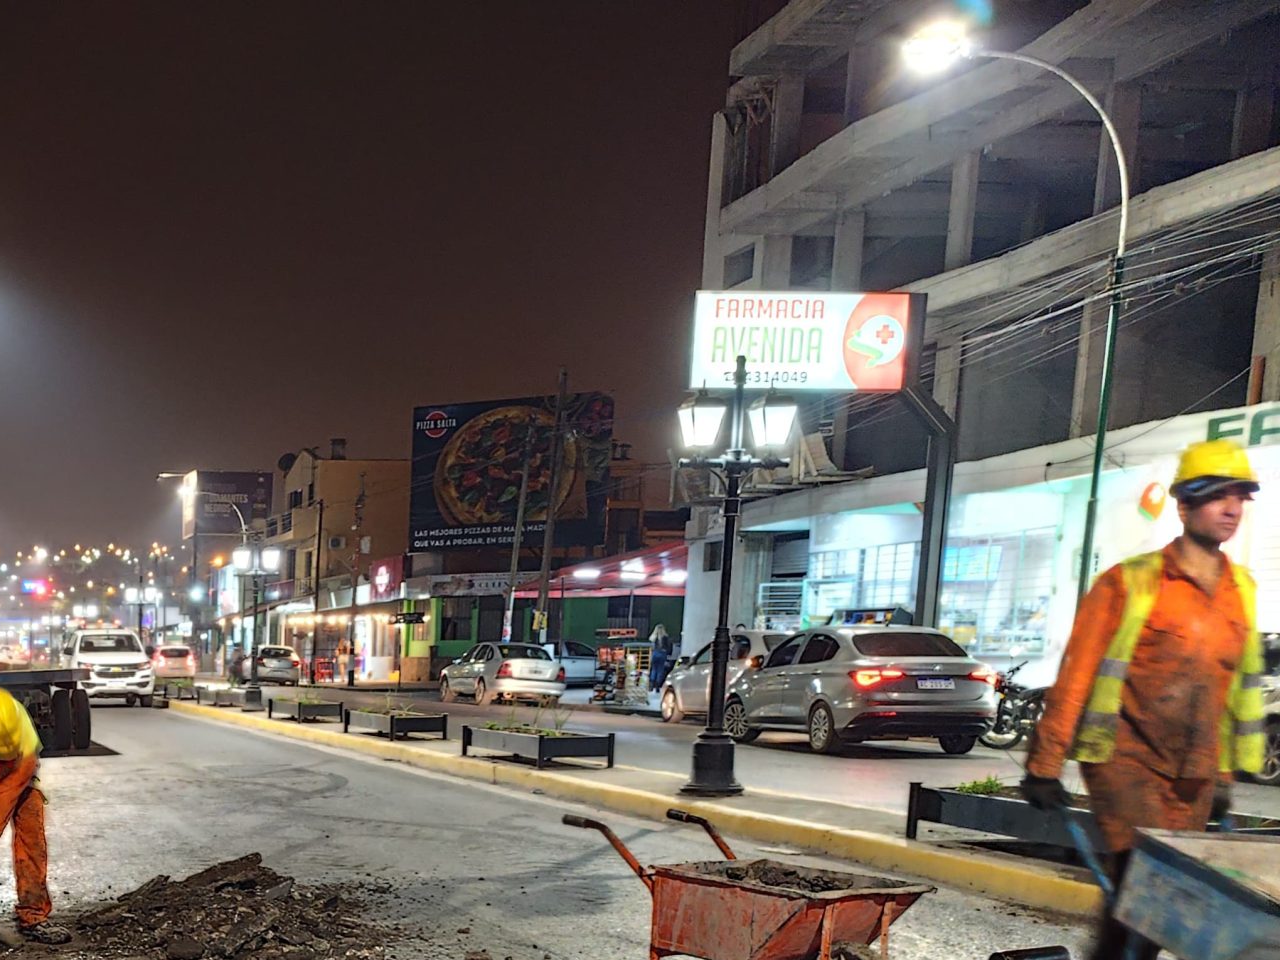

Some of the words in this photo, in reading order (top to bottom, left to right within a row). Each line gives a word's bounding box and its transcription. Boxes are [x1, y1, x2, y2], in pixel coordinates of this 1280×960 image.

[715, 298, 825, 319] FARMACIA
[711, 326, 824, 363] AVENIDA
[416, 420, 435, 430] PIZZA
[437, 418, 456, 428] SALTA
[429, 528, 463, 536] MEJORES
[464, 527, 491, 535] PIZZAS
[503, 525, 525, 533] MAA
